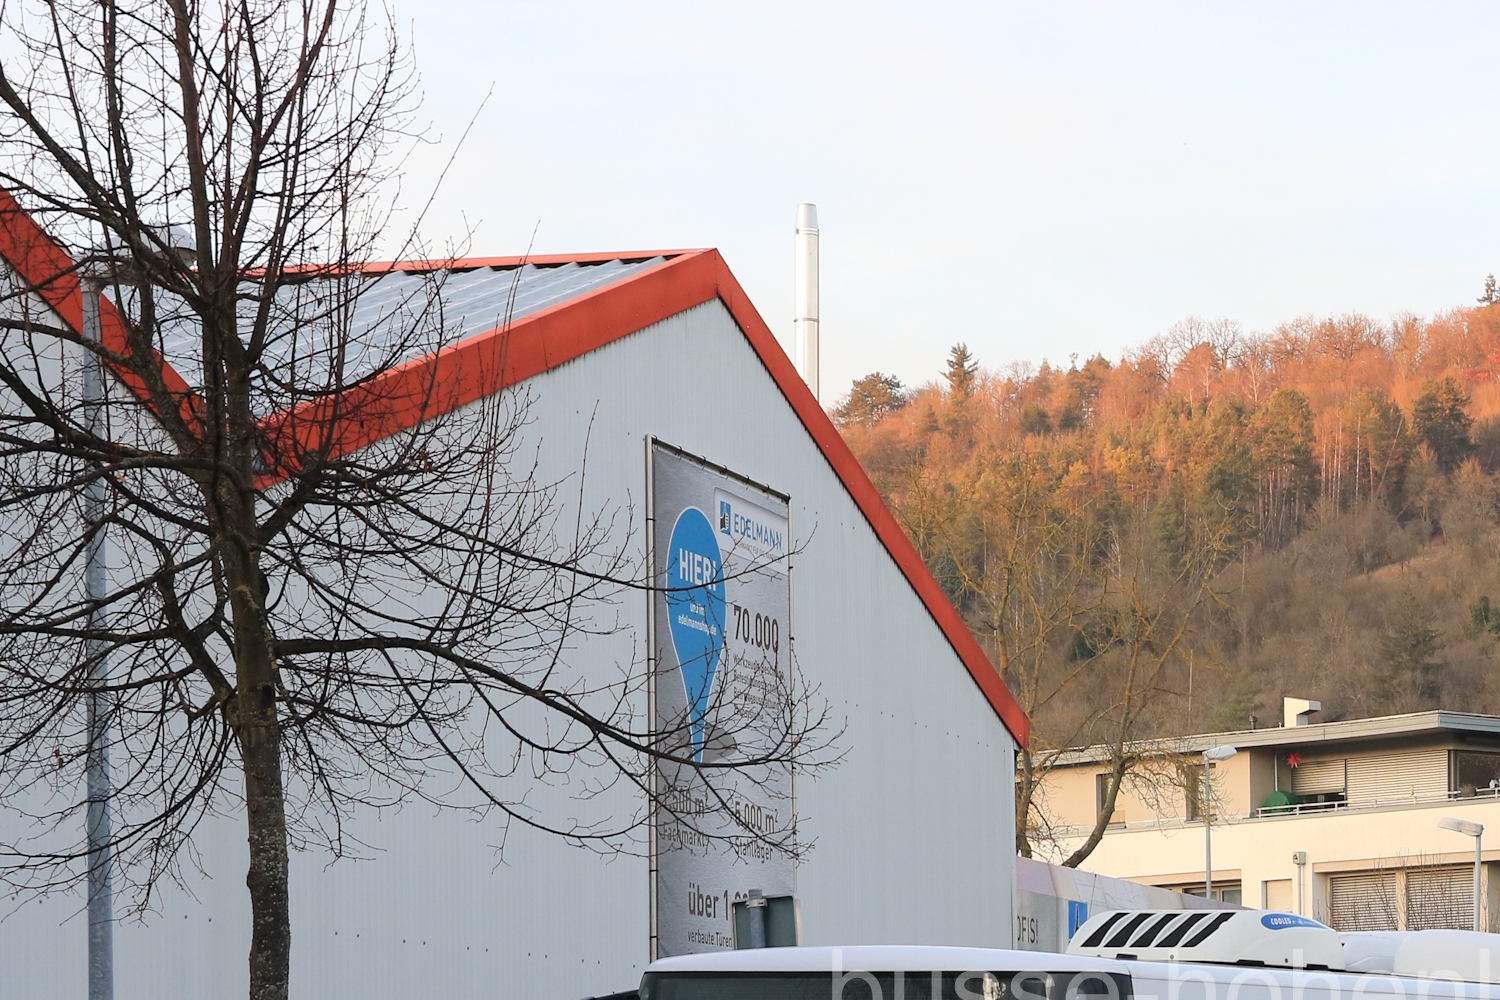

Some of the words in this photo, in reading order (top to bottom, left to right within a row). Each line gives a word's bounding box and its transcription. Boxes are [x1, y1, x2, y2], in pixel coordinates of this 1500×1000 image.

[734, 513, 782, 551] EDELMANN
[734, 605, 779, 654] 70.000
[688, 882, 719, 919] über
[687, 929, 714, 946] verbaute
[1270, 917, 1292, 925] COOLED
